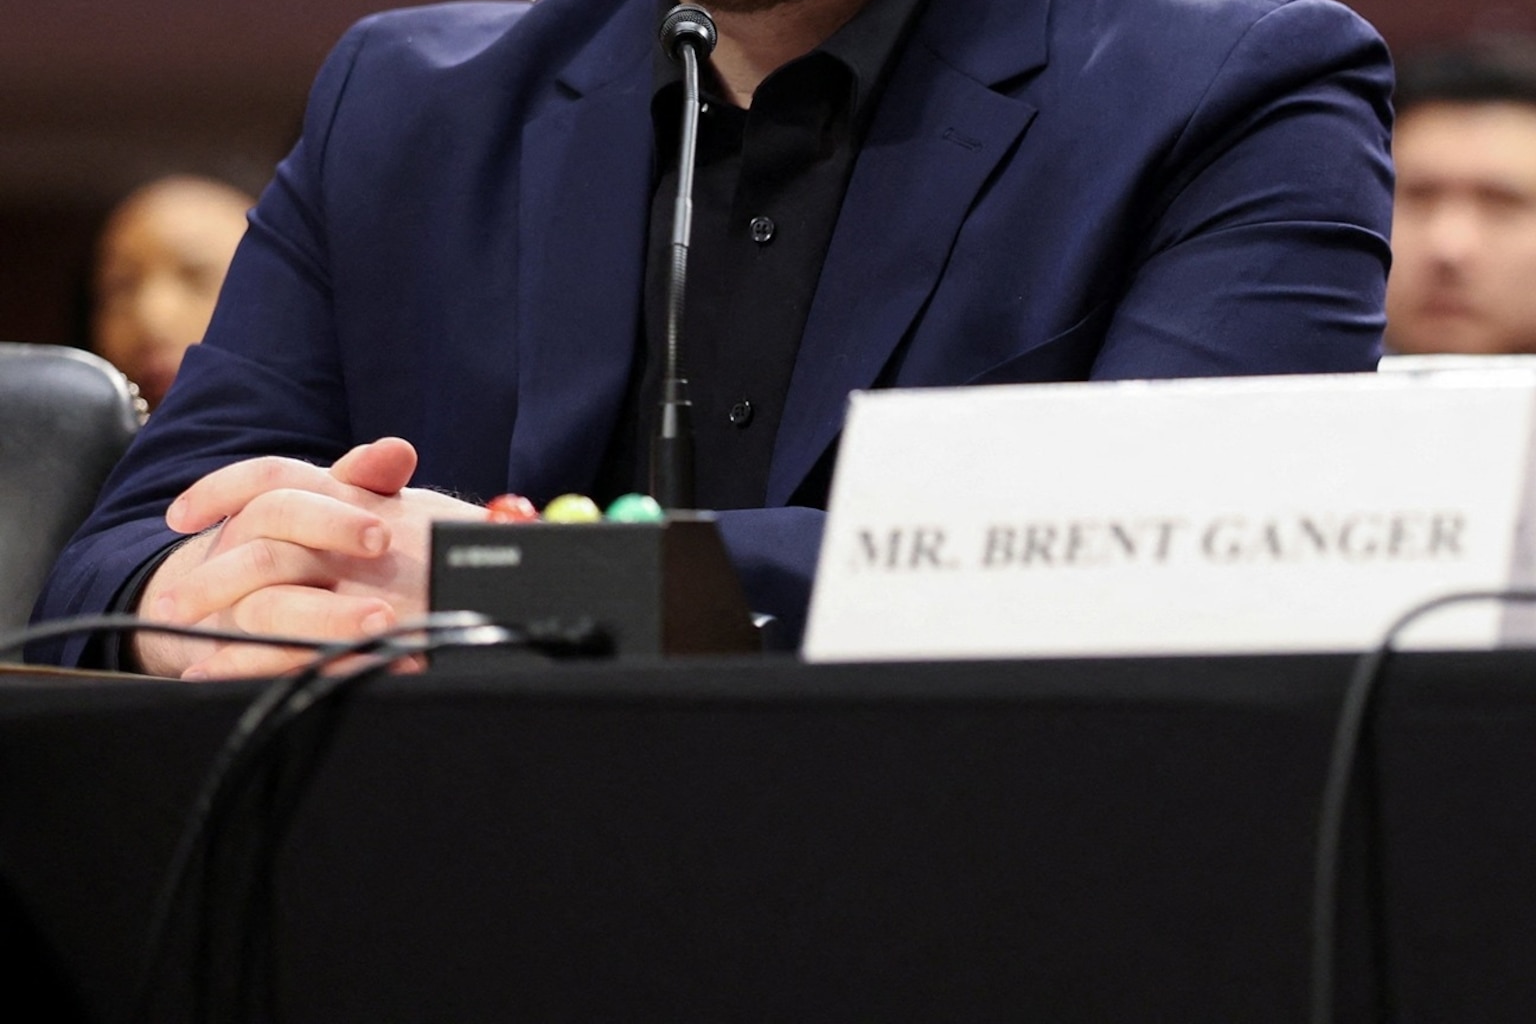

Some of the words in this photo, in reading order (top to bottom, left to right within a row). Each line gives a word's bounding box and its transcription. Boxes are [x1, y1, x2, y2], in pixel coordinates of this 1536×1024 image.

[850, 525, 961, 570] MR.
[980, 518, 1191, 568] BRENT
[1201, 510, 1467, 564] GANGER
